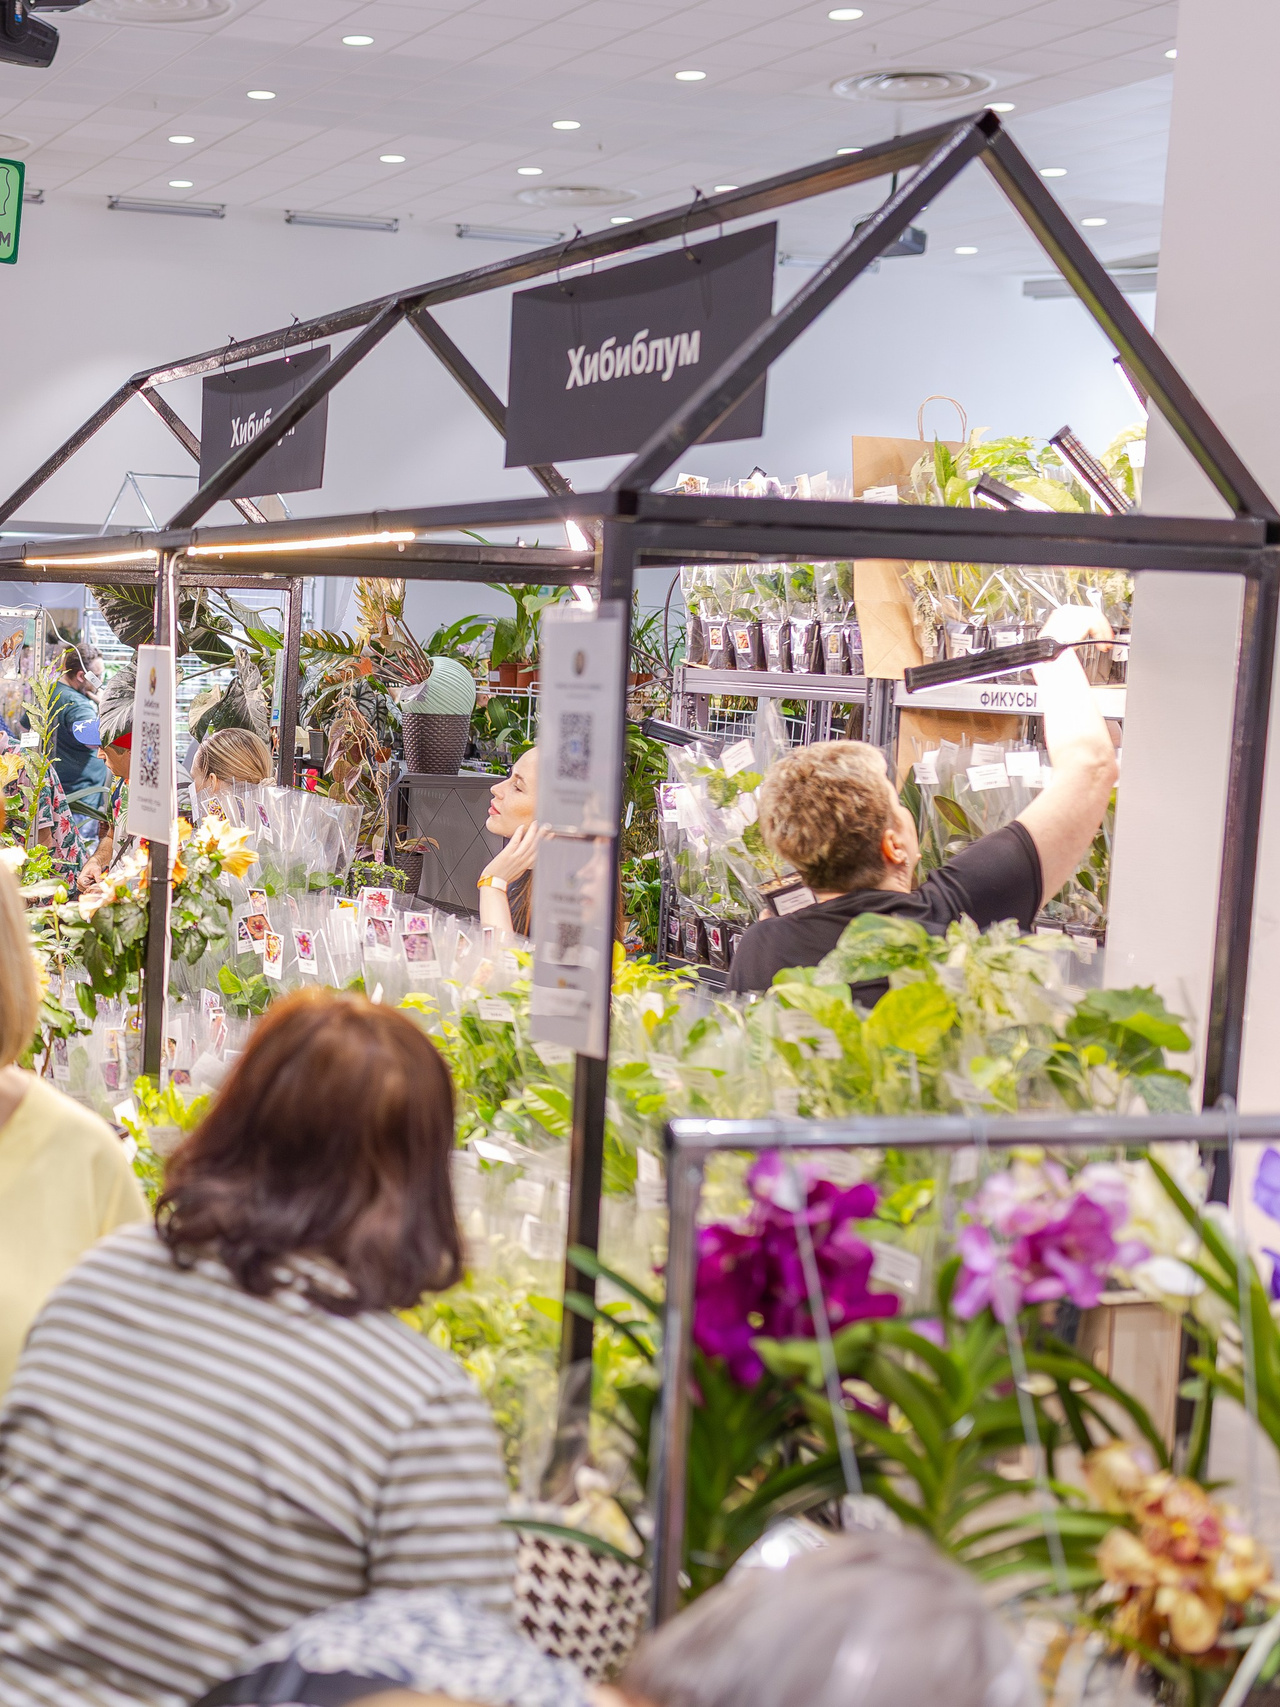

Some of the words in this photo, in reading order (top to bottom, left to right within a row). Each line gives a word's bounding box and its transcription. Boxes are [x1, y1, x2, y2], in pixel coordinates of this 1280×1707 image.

[565, 328, 701, 390] Хибиблум
[230, 407, 295, 448] Хибиб
[980, 691, 1037, 708] ФИКУСЫ
